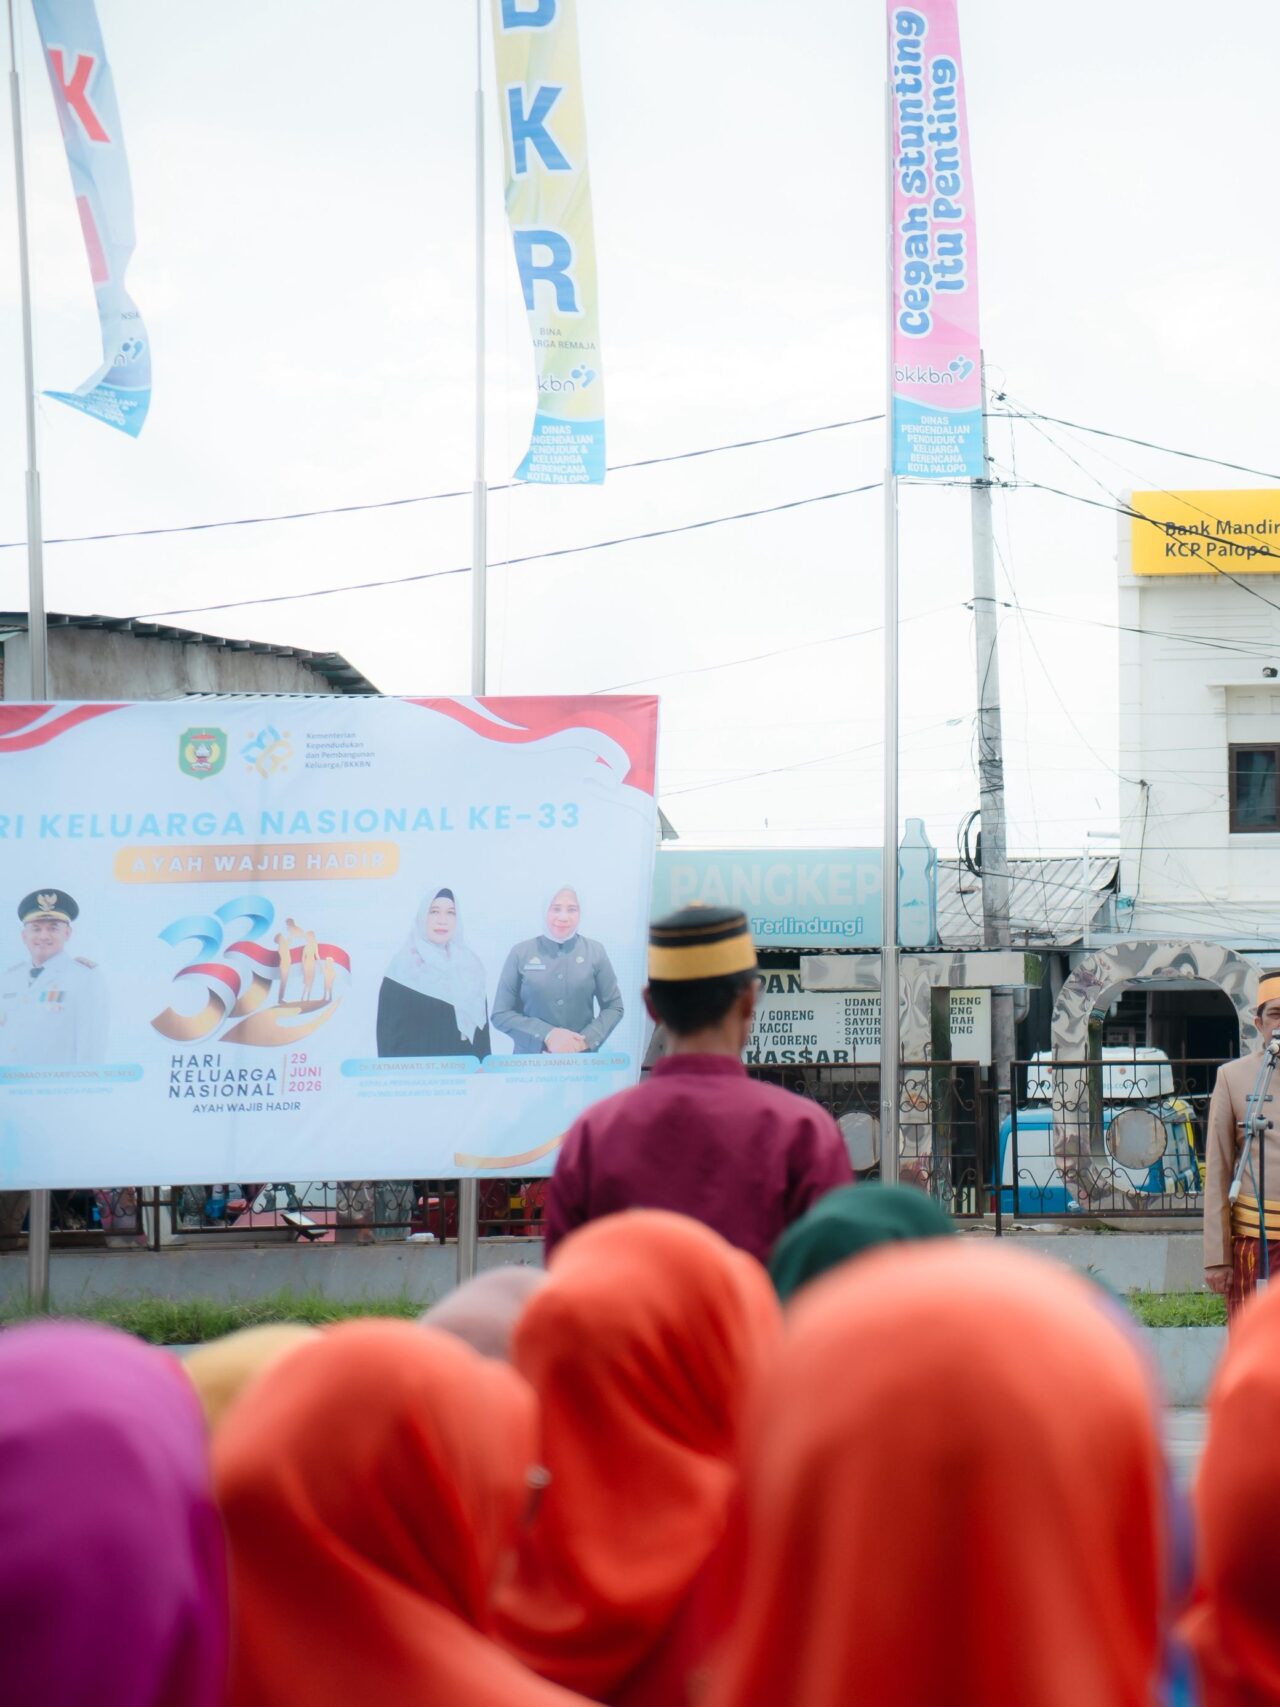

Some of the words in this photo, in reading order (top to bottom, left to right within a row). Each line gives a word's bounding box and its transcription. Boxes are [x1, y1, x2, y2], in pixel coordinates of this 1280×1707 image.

[932, 233, 965, 291] Itu
[539, 327, 562, 337] BINA
[558, 341, 596, 350] REMAJA
[894, 366, 953, 384] bkkbn
[920, 416, 949, 425] DINAS
[541, 425, 571, 435] DINAS
[901, 424, 971, 434] PENGENDALIAN
[907, 434, 958, 443] PENDUDUK
[913, 444, 960, 453] KELUARGA
[532, 454, 583, 464] KELUARGA
[910, 454, 963, 463] BERENCANA
[907, 463, 928, 473] KOTA
[930, 463, 967, 473] PALOPO
[553, 473, 590, 483] PALOPO
[1164, 520, 1210, 537] Bank
[1164, 542, 1201, 557] KCP
[1207, 541, 1270, 560] Palopo
[39, 811, 245, 839] KELUARGA
[260, 807, 454, 835] NASIONAL
[468, 803, 579, 831] KE-33
[131, 856, 203, 873] AYAH
[214, 854, 295, 872] WAJIB
[306, 852, 385, 870] HADIR
[668, 863, 882, 906] PANGKEP
[751, 916, 864, 937] Terlindungi
[768, 1010, 814, 1021] GORENG
[844, 1008, 874, 1016] CUMI
[844, 1017, 881, 1026] SAYUR
[759, 1023, 793, 1033] KACCI
[844, 1027, 881, 1036] SAYUR
[772, 1034, 818, 1046] GORENG
[844, 1036, 881, 1045] SAYUR
[171, 1053, 221, 1068] HARI
[291, 1053, 307, 1064] 29
[170, 1068, 277, 1083] KELUARGA
[289, 1066, 322, 1077] JUNI
[168, 1083, 275, 1098] NASIONAL
[288, 1081, 322, 1092] 2026
[192, 1104, 224, 1113] AYAH
[227, 1102, 263, 1112] WAJIB
[266, 1101, 301, 1111] HADIR
